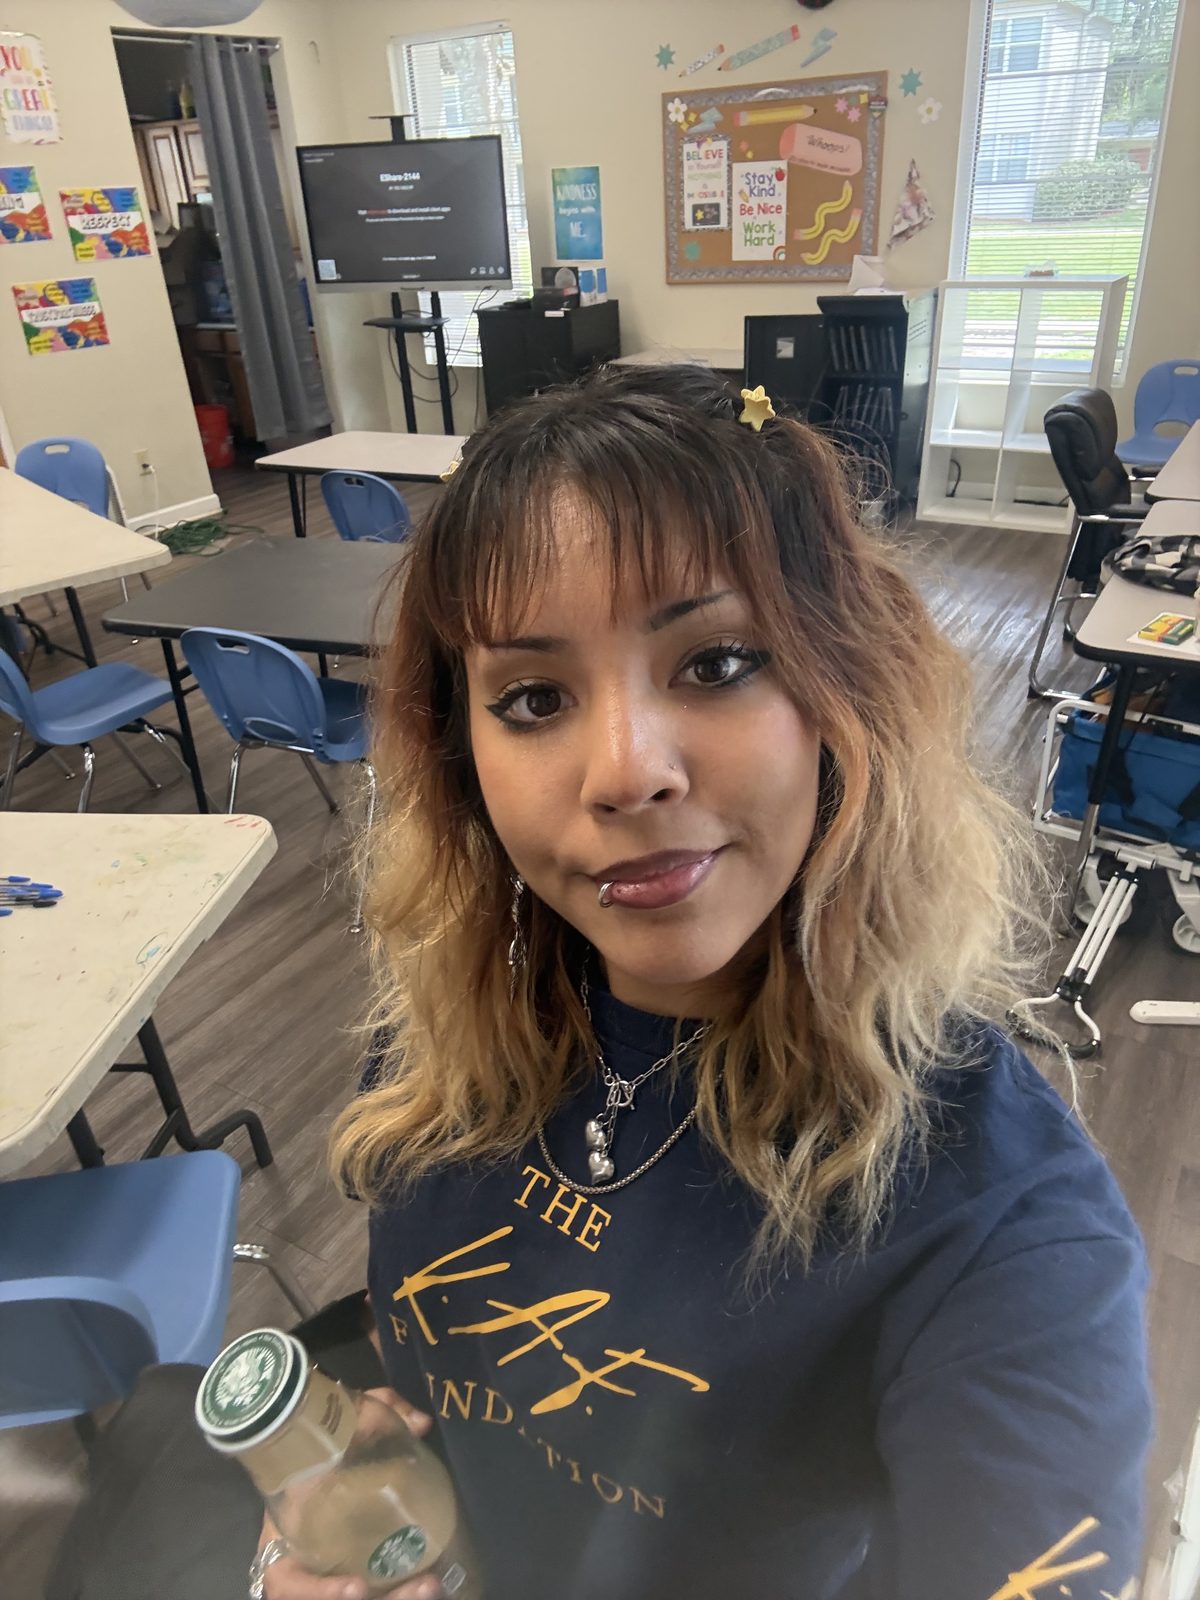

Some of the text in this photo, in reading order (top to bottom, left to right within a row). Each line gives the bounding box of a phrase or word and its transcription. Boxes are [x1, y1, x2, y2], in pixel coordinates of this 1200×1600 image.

[744, 172, 774, 186] Stay
[749, 184, 776, 197] Kind
[739, 203, 783, 216] Be Nice
[743, 221, 776, 234] Work
[744, 234, 775, 247] Hard
[514, 1165, 611, 1252] THE
